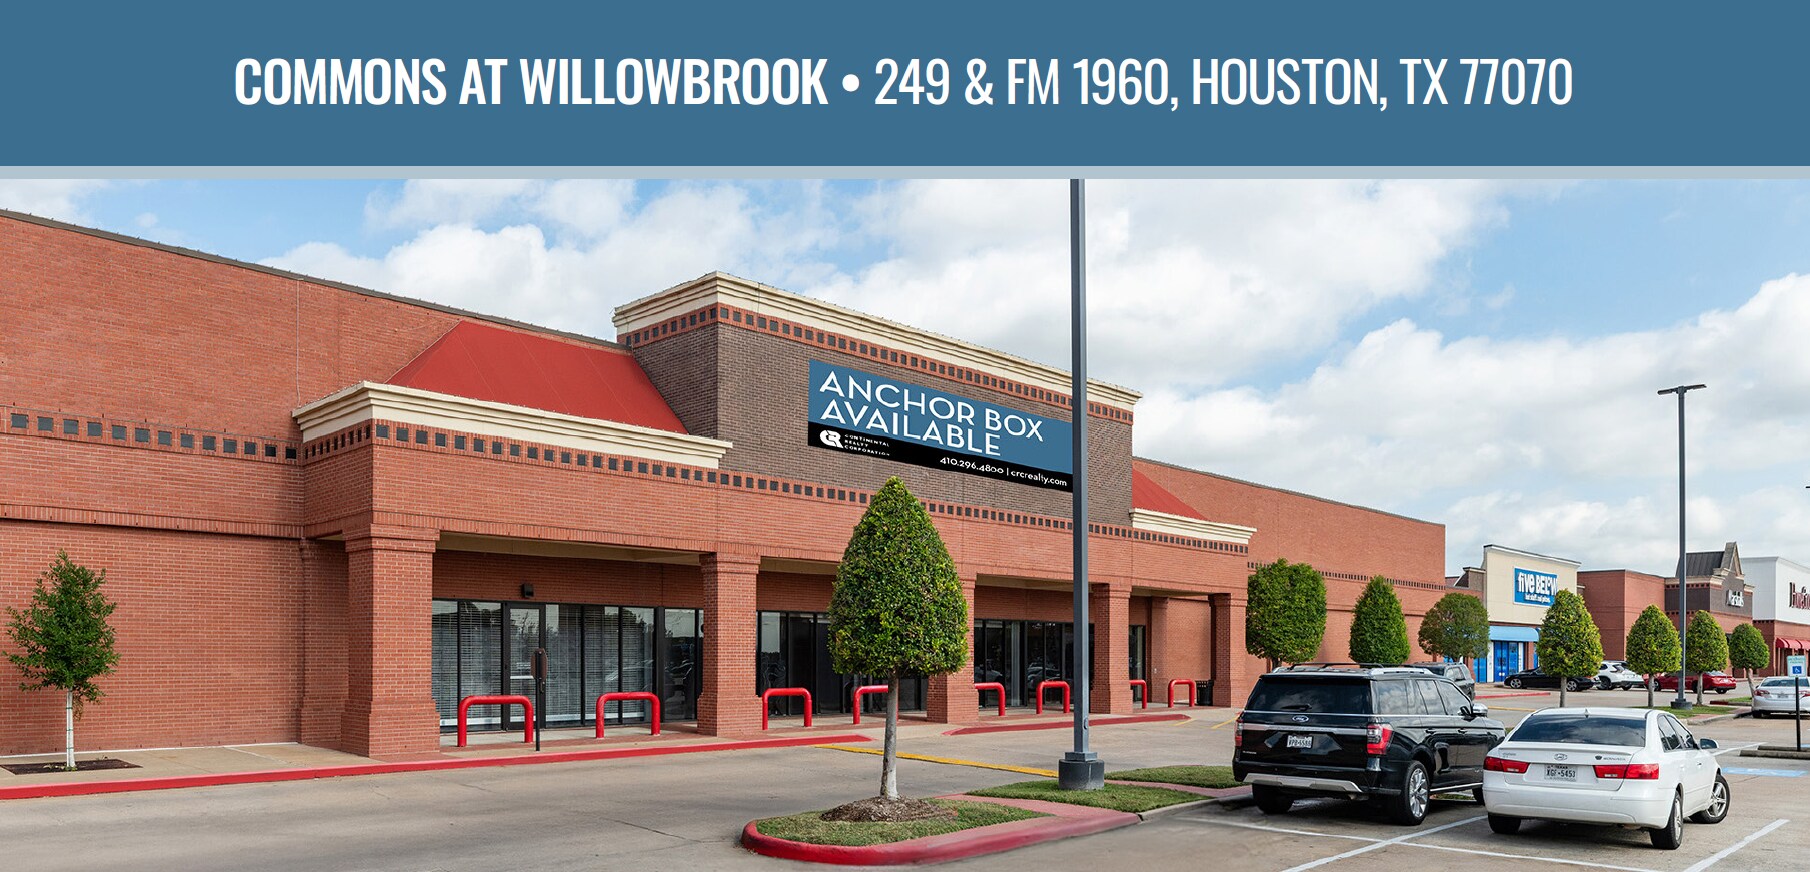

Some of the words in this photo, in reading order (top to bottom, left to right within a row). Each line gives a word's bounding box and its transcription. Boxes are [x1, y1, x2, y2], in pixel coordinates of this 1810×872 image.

[819, 370, 975, 426] ANCHOR
[985, 408, 1044, 442] BOX
[819, 399, 1001, 456] AVAILABLE
[844, 433, 890, 447] CONTINENTAL
[844, 440, 869, 448] REALTY
[844, 445, 890, 456] CORPORATION
[939, 457, 1004, 474] 410.296.4800
[1010, 470, 1068, 487] crcrealty.com
[1518, 572, 1535, 593] five
